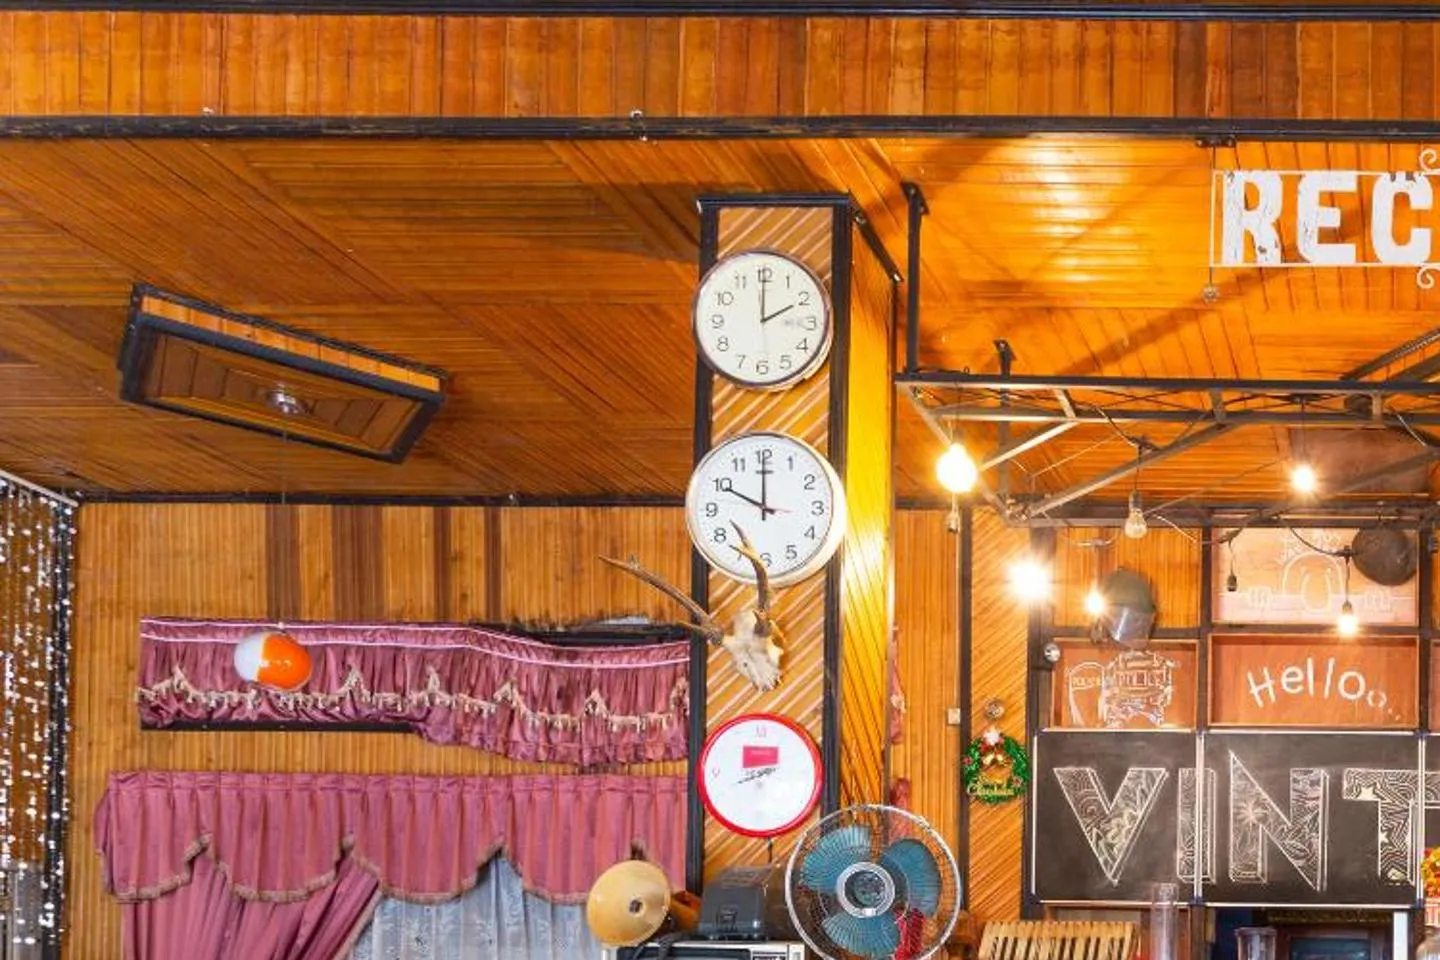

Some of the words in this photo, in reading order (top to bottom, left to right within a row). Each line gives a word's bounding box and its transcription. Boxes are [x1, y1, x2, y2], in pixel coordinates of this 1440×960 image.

[735, 274, 747, 289] 11
[714, 290, 735, 306] 10
[798, 291, 811, 306] 2
[711, 313, 725, 329] 9
[804, 316, 818, 331] 3
[716, 336, 729, 352] 8
[795, 338, 809, 353] 4
[736, 354, 746, 369] 7
[755, 360, 769, 375] 6
[779, 354, 792, 369] 5
[731, 457, 746, 472] 11
[712, 477, 733, 492] 10
[803, 474, 816, 490] 2
[705, 502, 719, 518] 9
[811, 500, 825, 516] 3
[713, 527, 727, 543] 8
[803, 525, 816, 541] 4
[785, 544, 798, 560] 5
